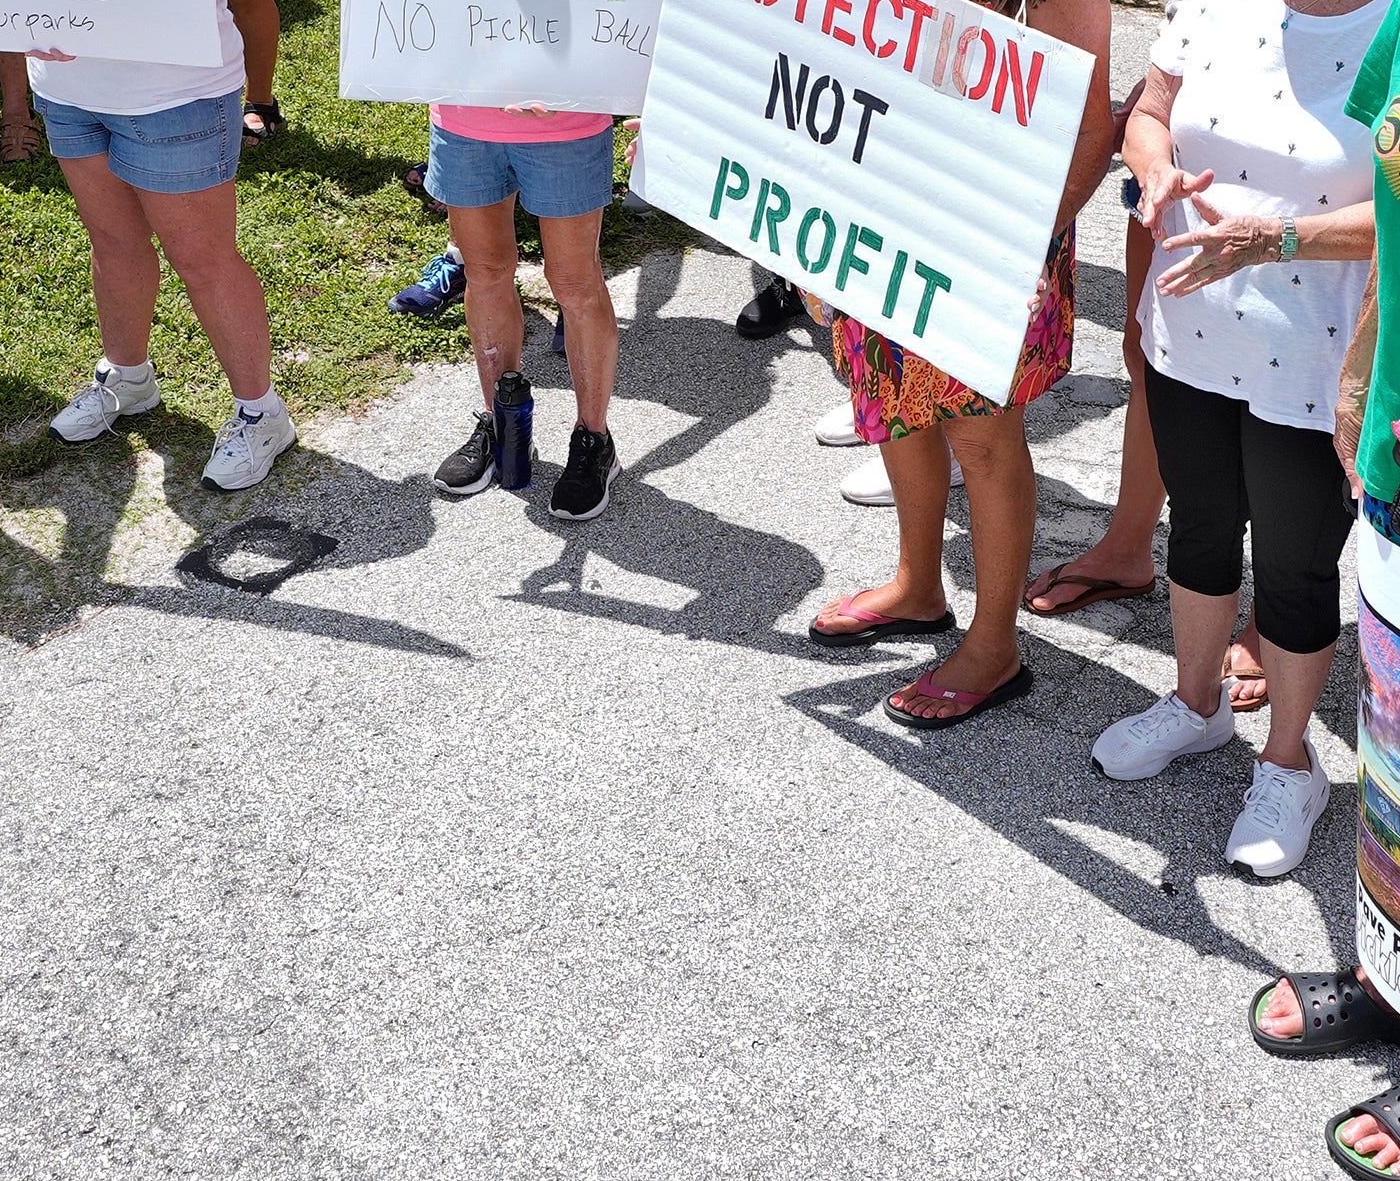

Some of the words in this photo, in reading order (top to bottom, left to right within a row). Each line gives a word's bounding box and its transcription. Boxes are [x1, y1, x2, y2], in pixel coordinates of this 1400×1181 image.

[467, 3, 561, 47] PICKLE
[590, 9, 651, 58] BALL
[764, 51, 890, 166] NOT
[708, 155, 953, 340] PROFIT
